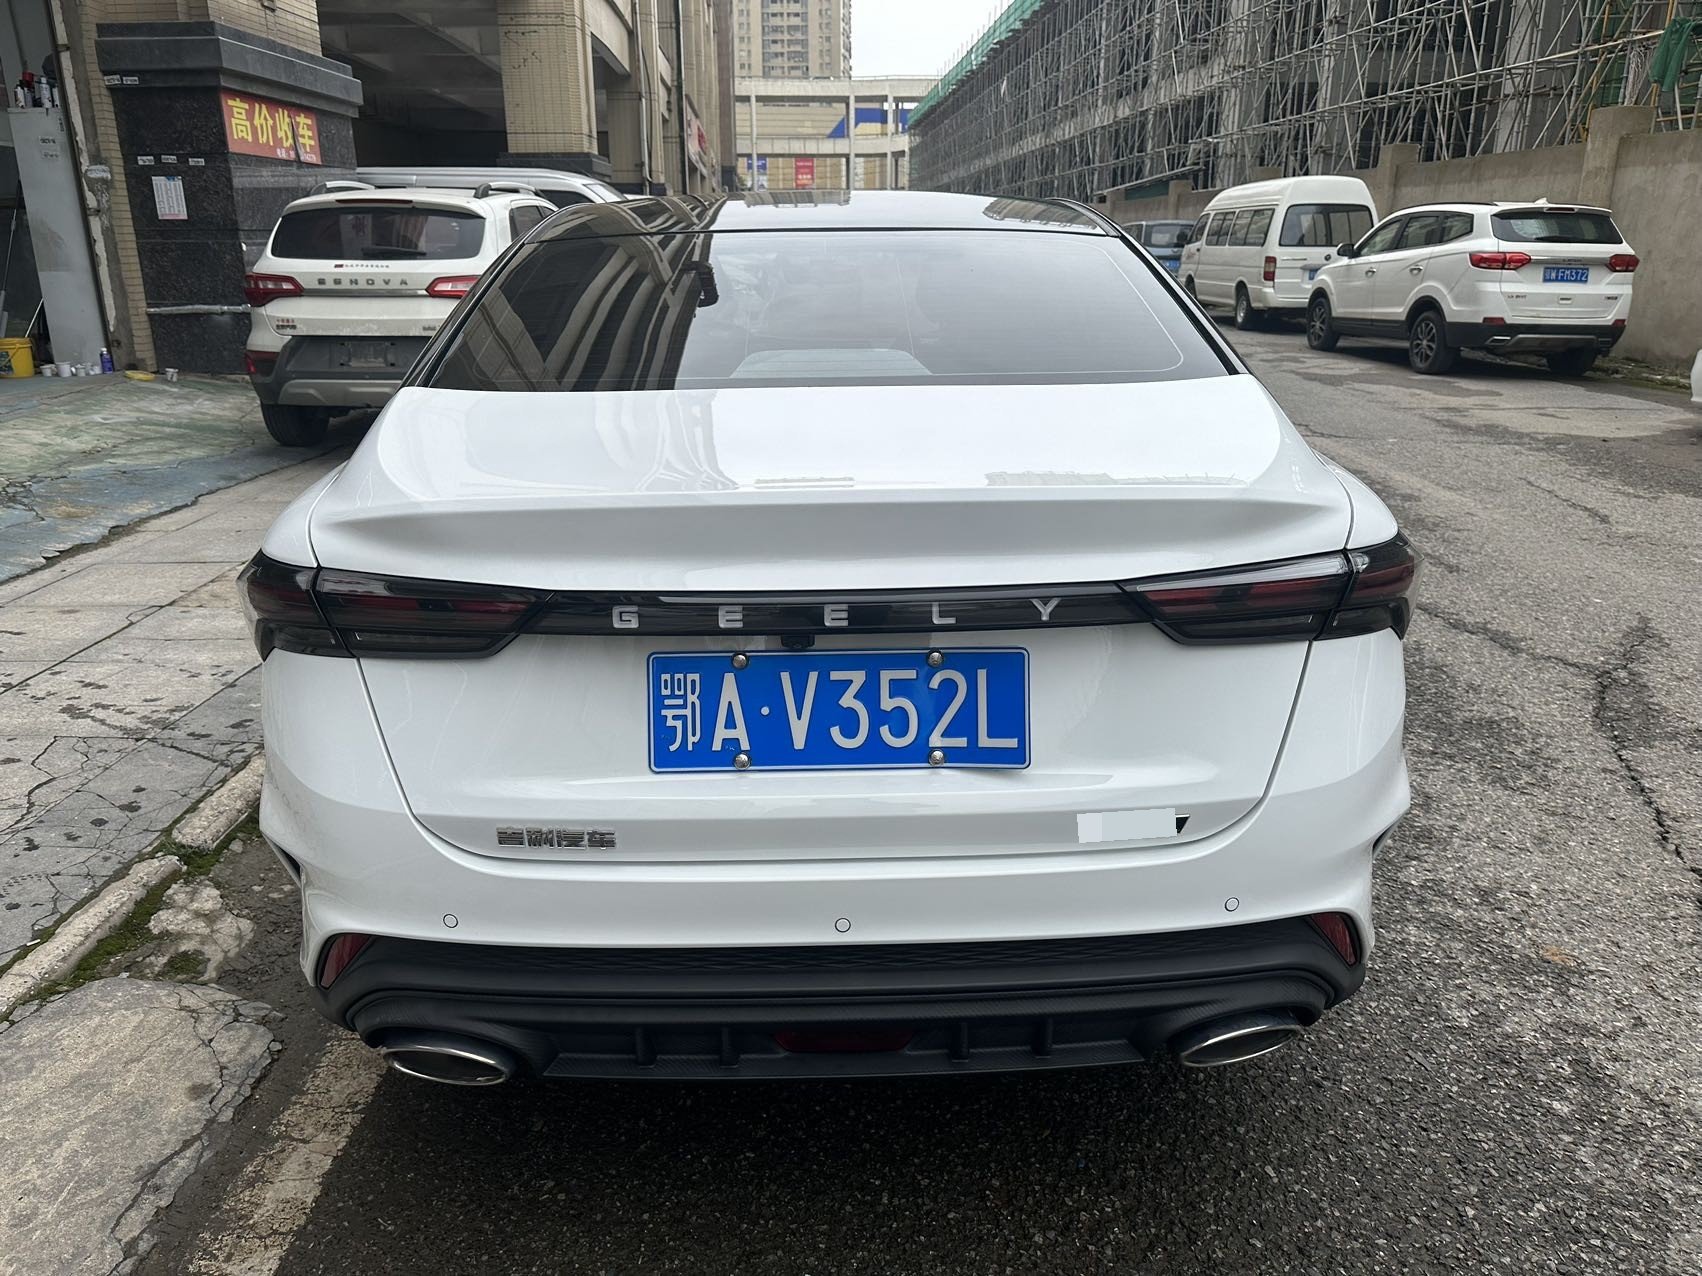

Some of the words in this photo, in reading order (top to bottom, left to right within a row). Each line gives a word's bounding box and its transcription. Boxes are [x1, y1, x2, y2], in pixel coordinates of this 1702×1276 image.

[227, 98, 315, 152] 高价收车
[612, 598, 1061, 629] GEELY
[661, 668, 1018, 751] 鄂A·V352L
